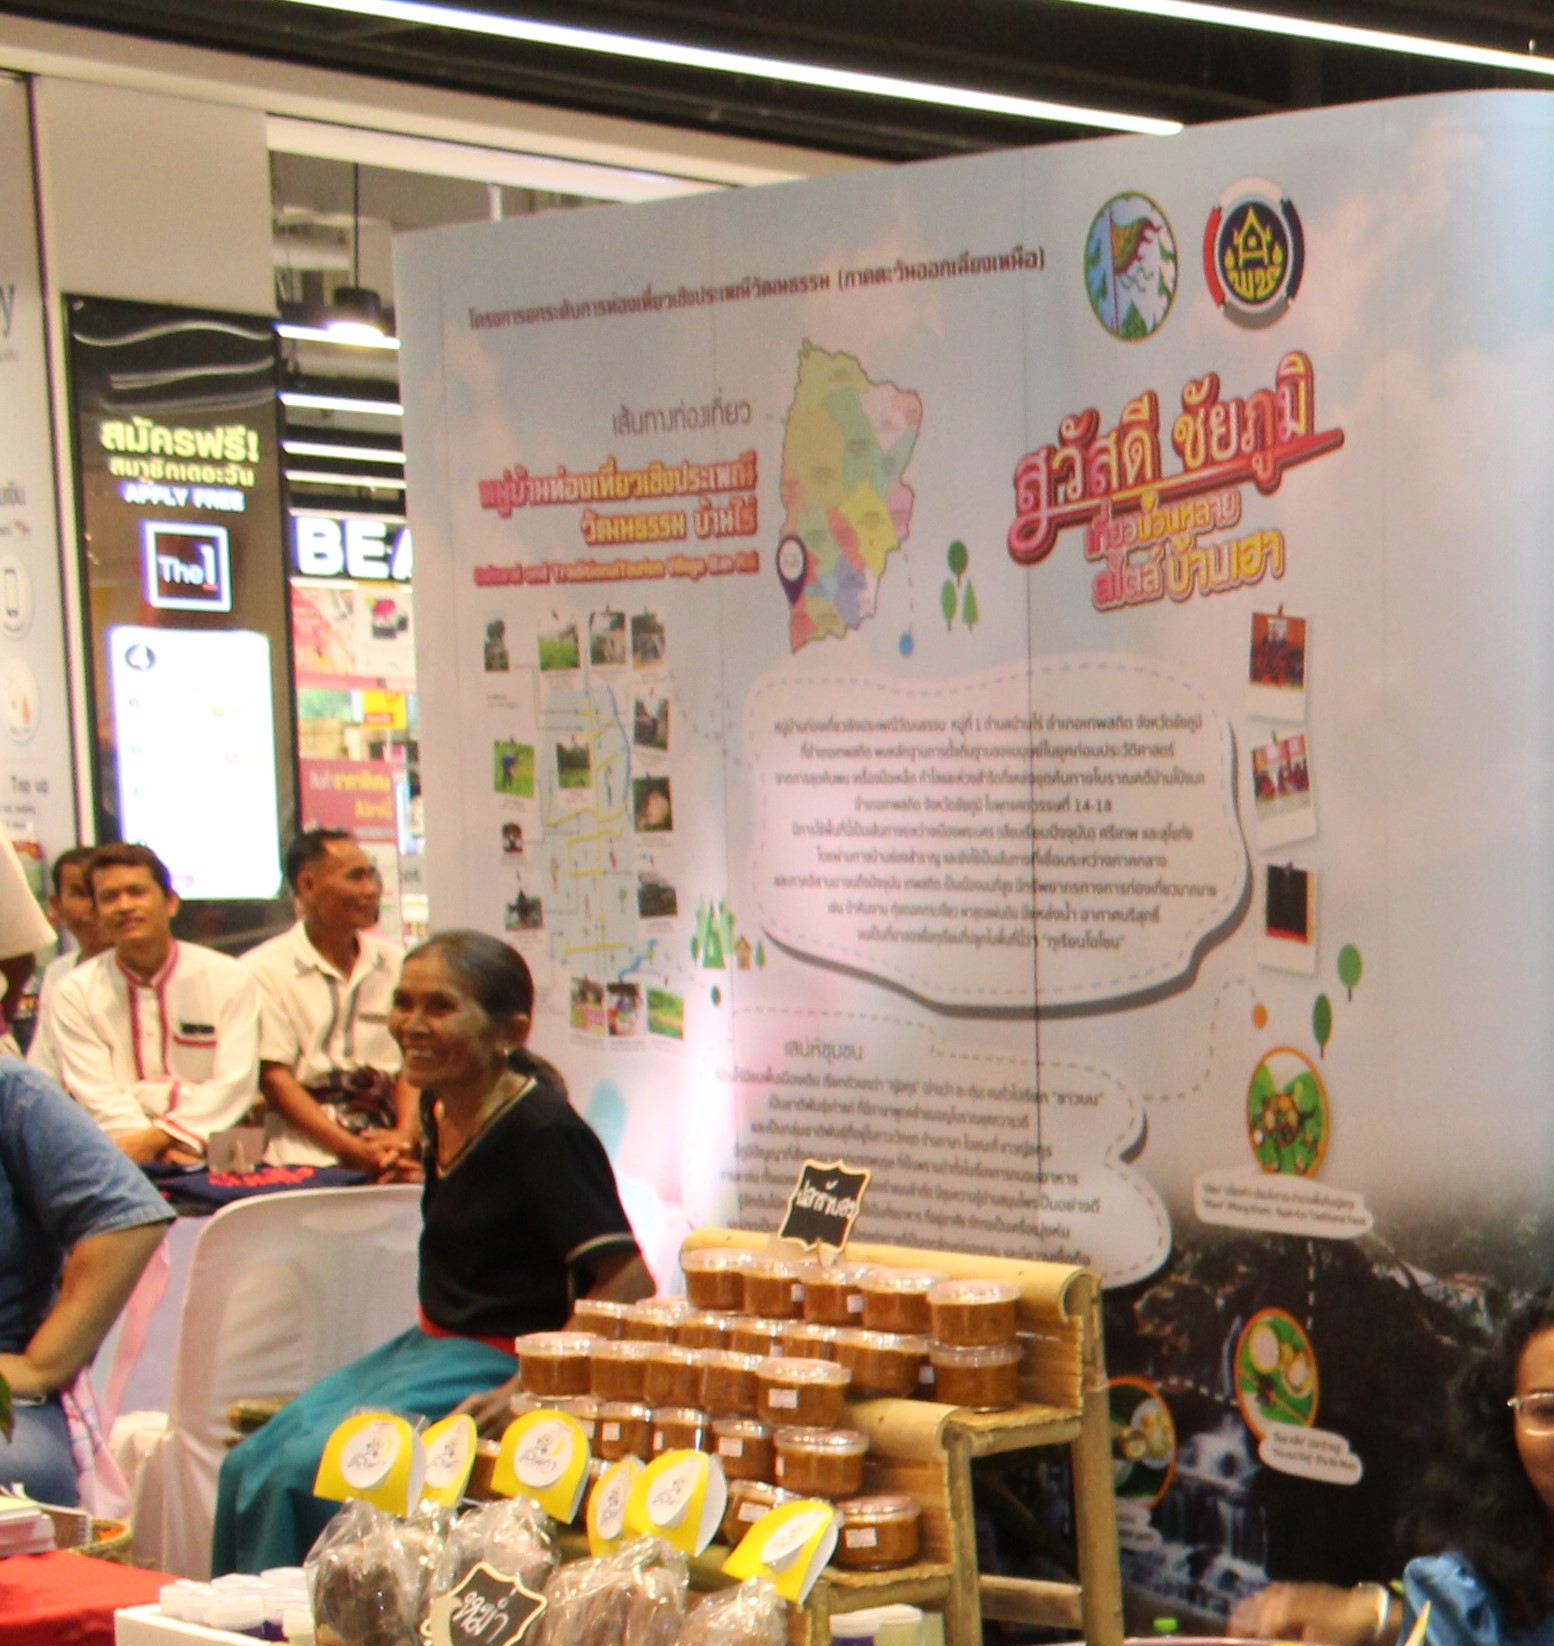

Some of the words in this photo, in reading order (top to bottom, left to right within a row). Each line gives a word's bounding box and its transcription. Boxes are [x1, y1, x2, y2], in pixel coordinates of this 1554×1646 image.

[1009, 390, 1160, 566] สวัสดี
[1172, 350, 1315, 496] ชัยภูมิ
[121, 480, 189, 509] APPLY
[192, 486, 246, 513] FREE
[1166, 530, 1286, 602] บ้านเฮา
